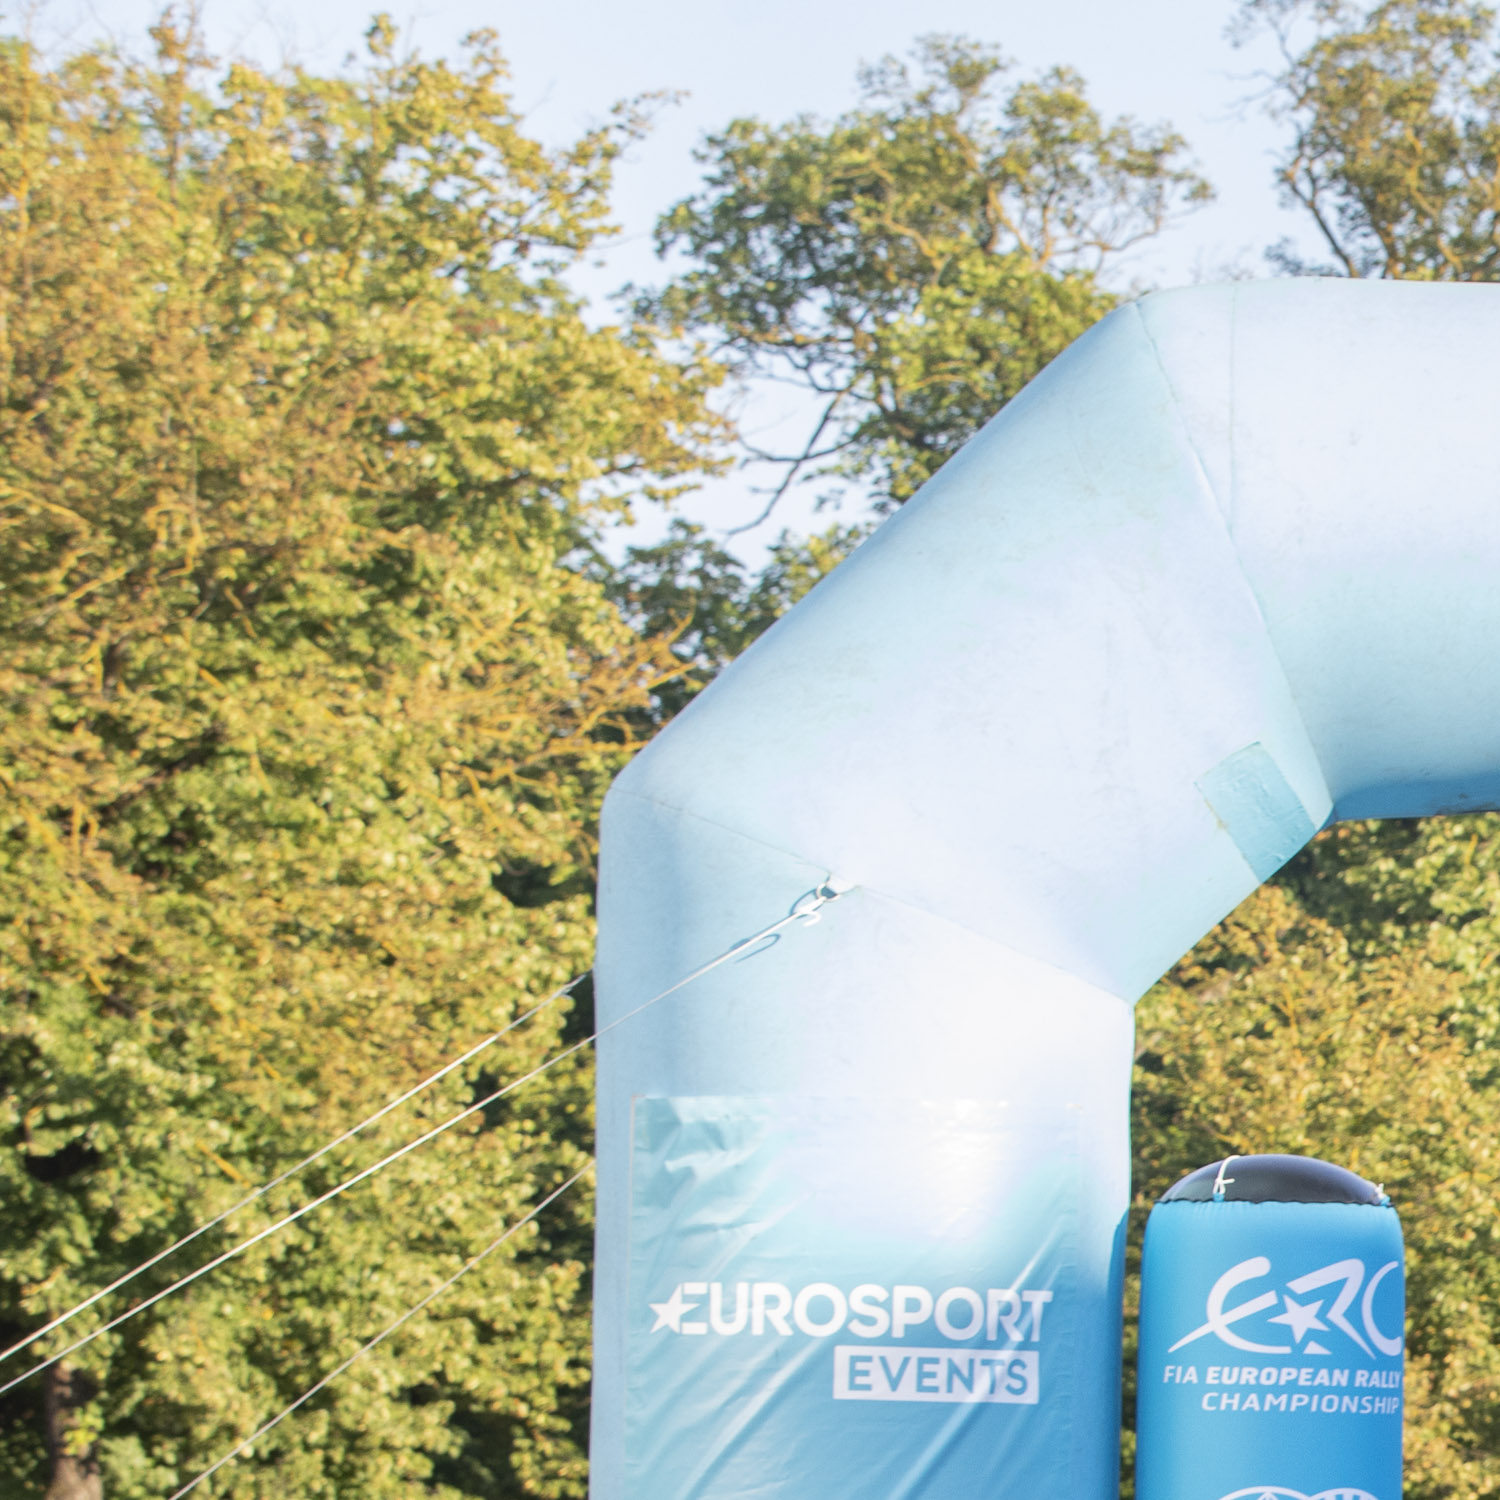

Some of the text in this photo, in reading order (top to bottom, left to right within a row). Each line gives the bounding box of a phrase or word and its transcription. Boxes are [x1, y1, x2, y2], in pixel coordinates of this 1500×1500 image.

[678, 1281, 1054, 1343] EUROSPORT
[1168, 1256, 1402, 1359] ERC
[847, 1356, 1029, 1397] EVENTS
[1163, 1365, 1401, 1388] FIA EUROPEAN RALLY
[1200, 1392, 1401, 1415] CHAMPIONSHIP
